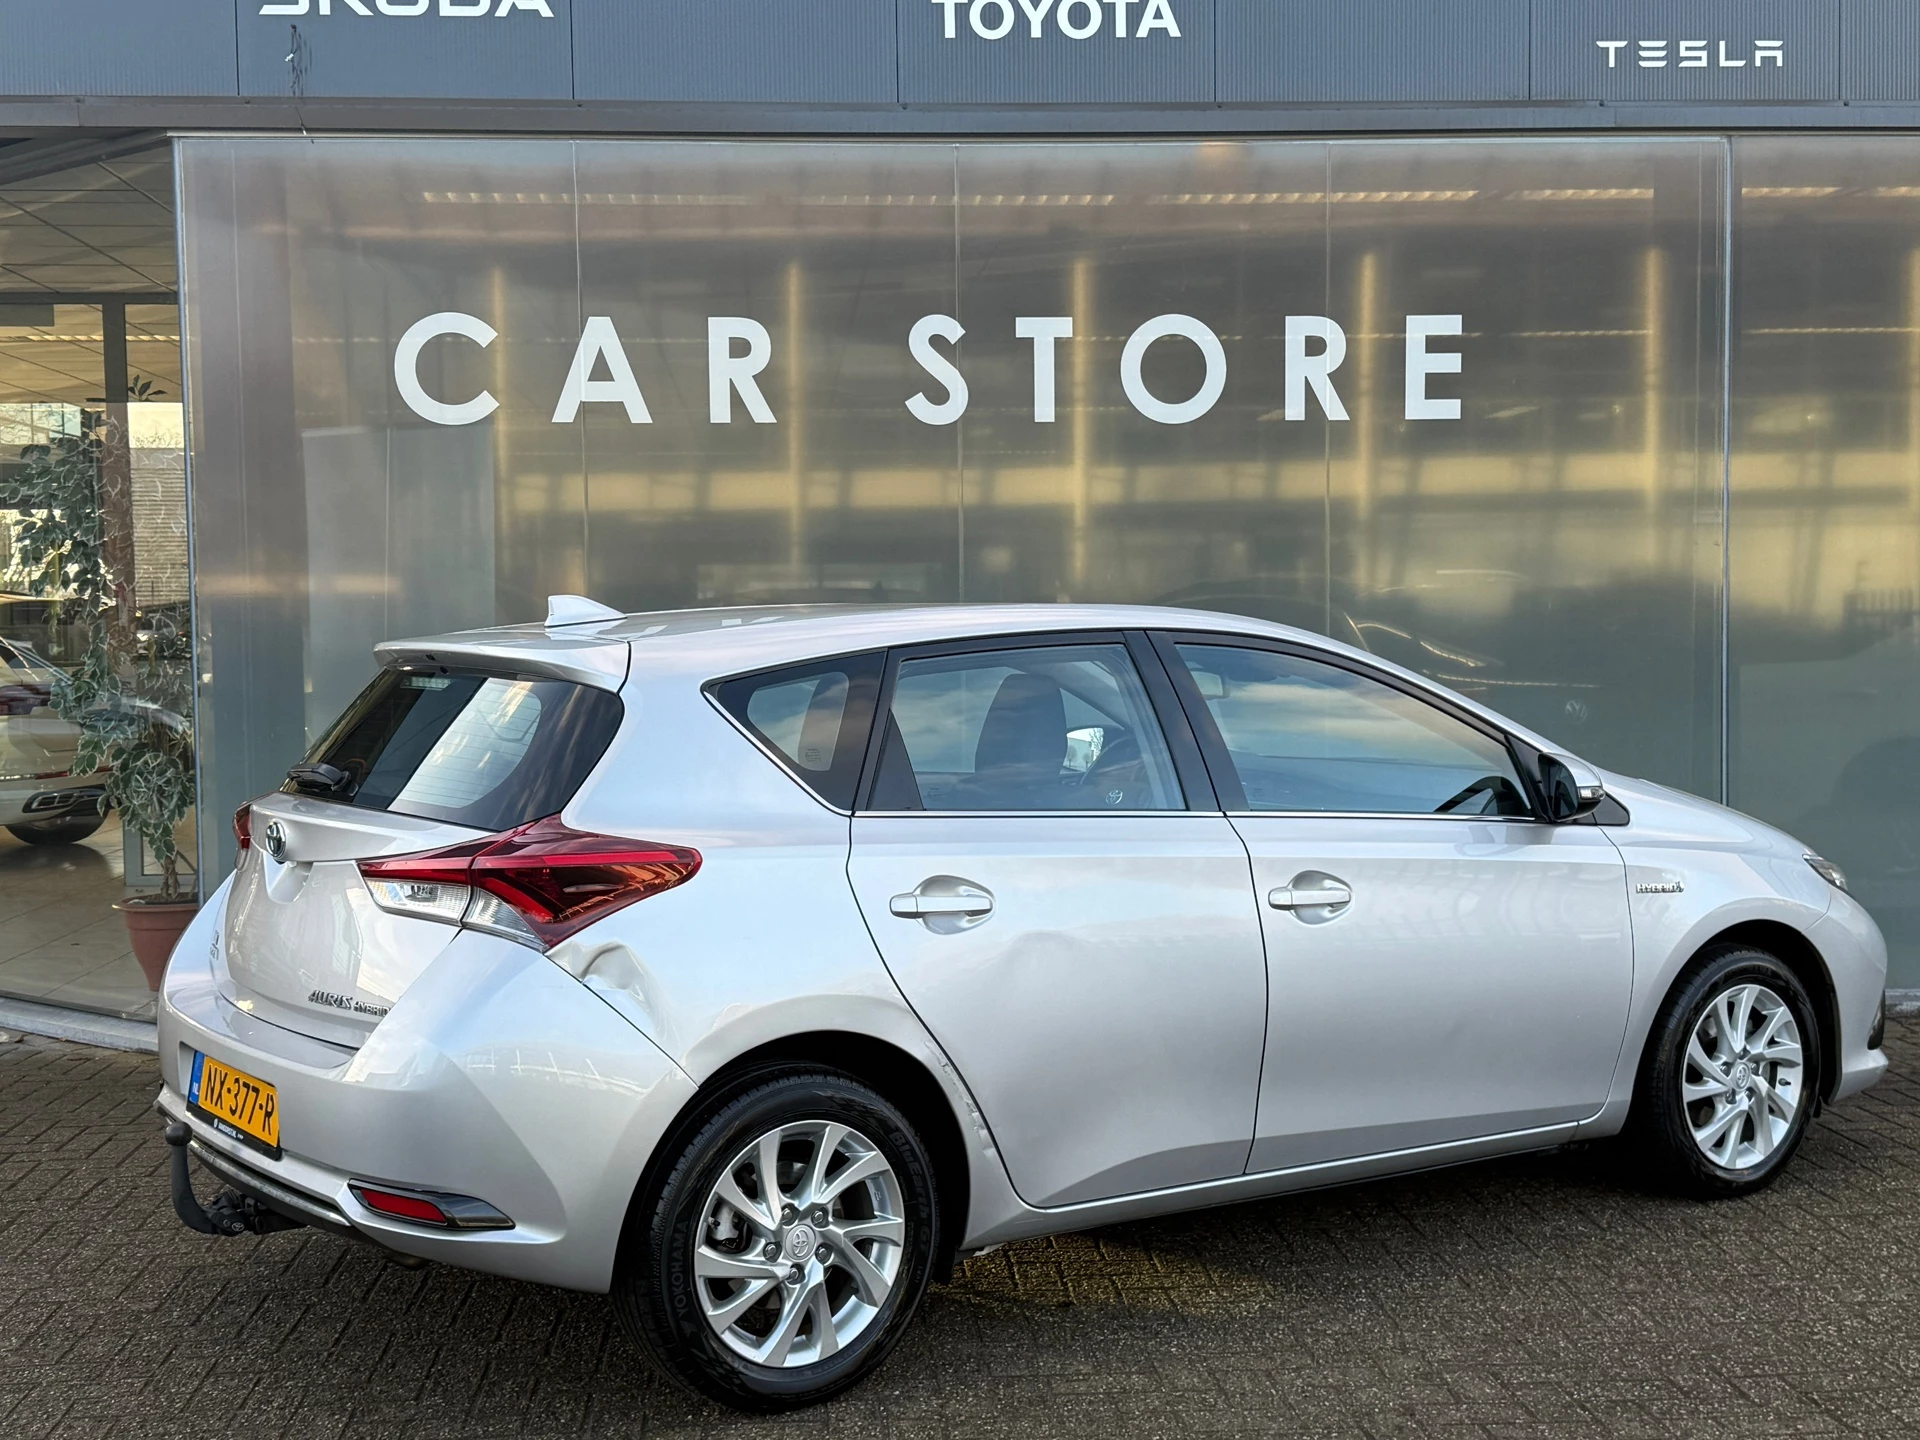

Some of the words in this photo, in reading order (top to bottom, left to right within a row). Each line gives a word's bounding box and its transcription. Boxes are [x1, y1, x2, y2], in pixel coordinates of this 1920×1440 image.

[931, 0, 1182, 40] TOYOTA
[1595, 40, 1784, 68] TESLA
[394, 312, 778, 426] CAR
[904, 313, 1463, 426] STORE
[308, 989, 353, 1010] AURIS
[204, 1064, 275, 1136] NX-377-R
[671, 1220, 689, 1317] YOKOHAMA
